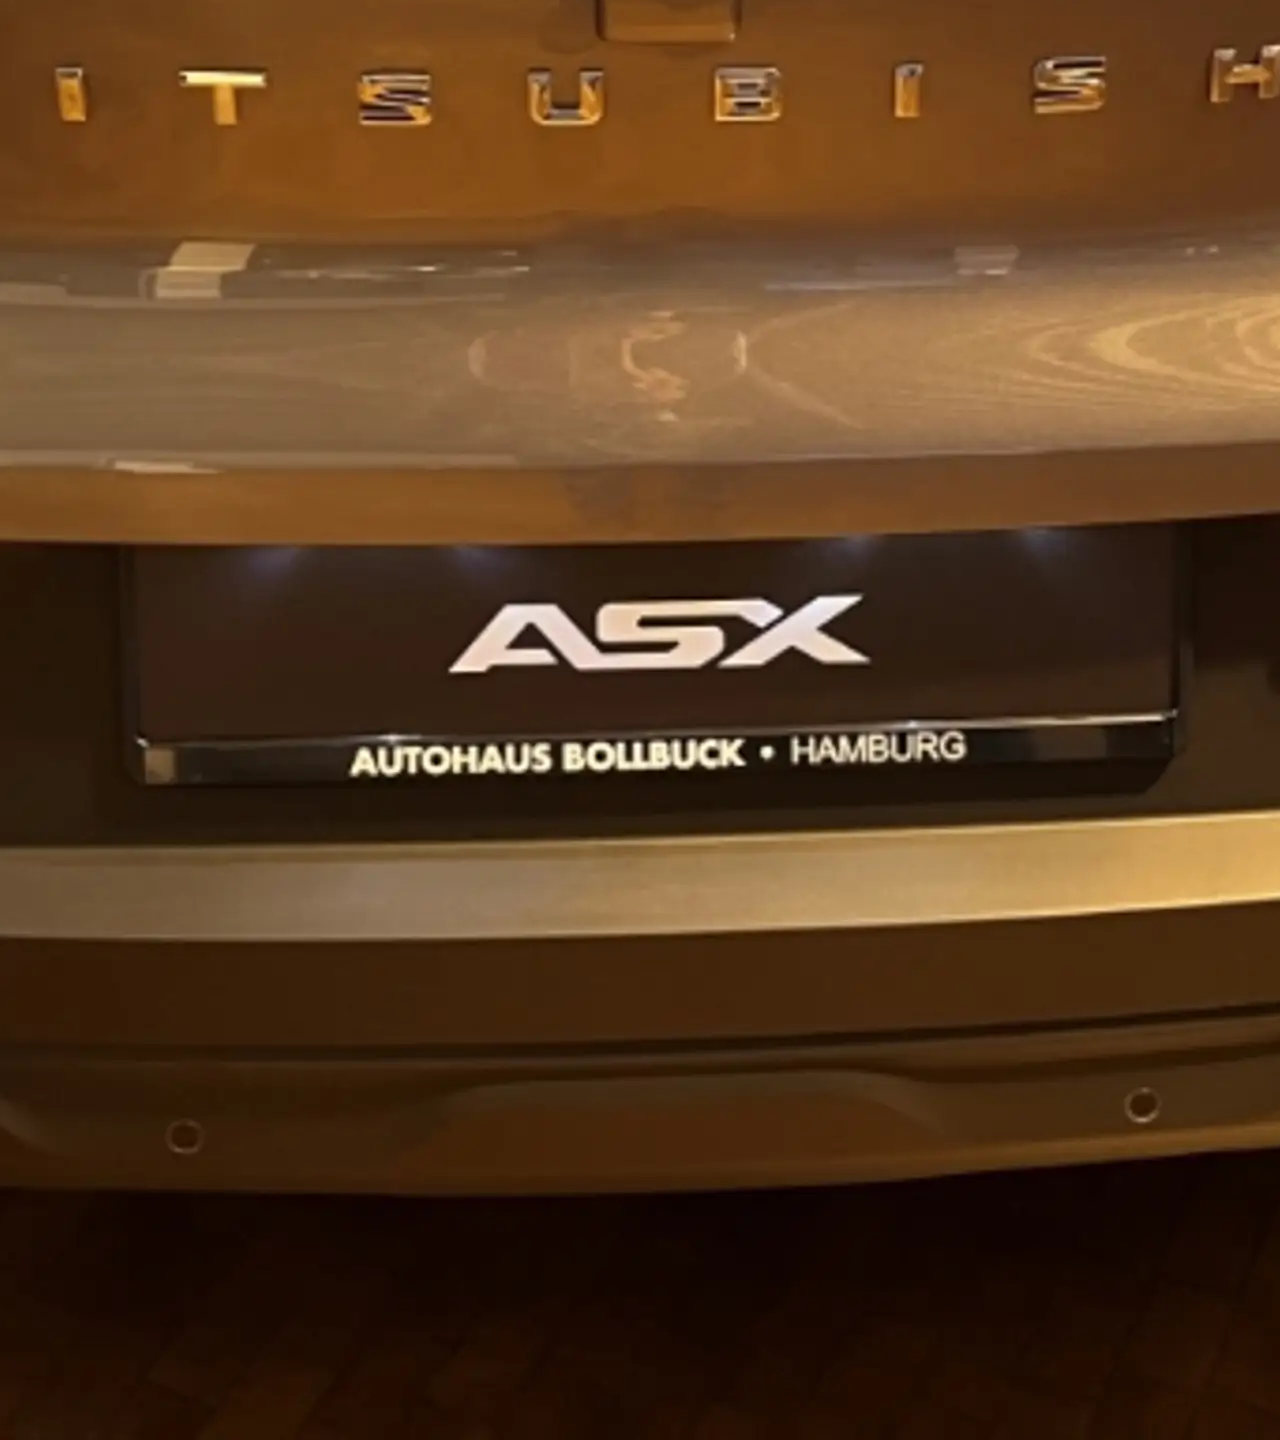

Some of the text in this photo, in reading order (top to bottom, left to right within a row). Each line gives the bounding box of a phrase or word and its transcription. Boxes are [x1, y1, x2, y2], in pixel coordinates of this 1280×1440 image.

[448, 595, 871, 673] ASX
[350, 730, 967, 778] AUTOHAUS BOLLBUCK HAMBURG
